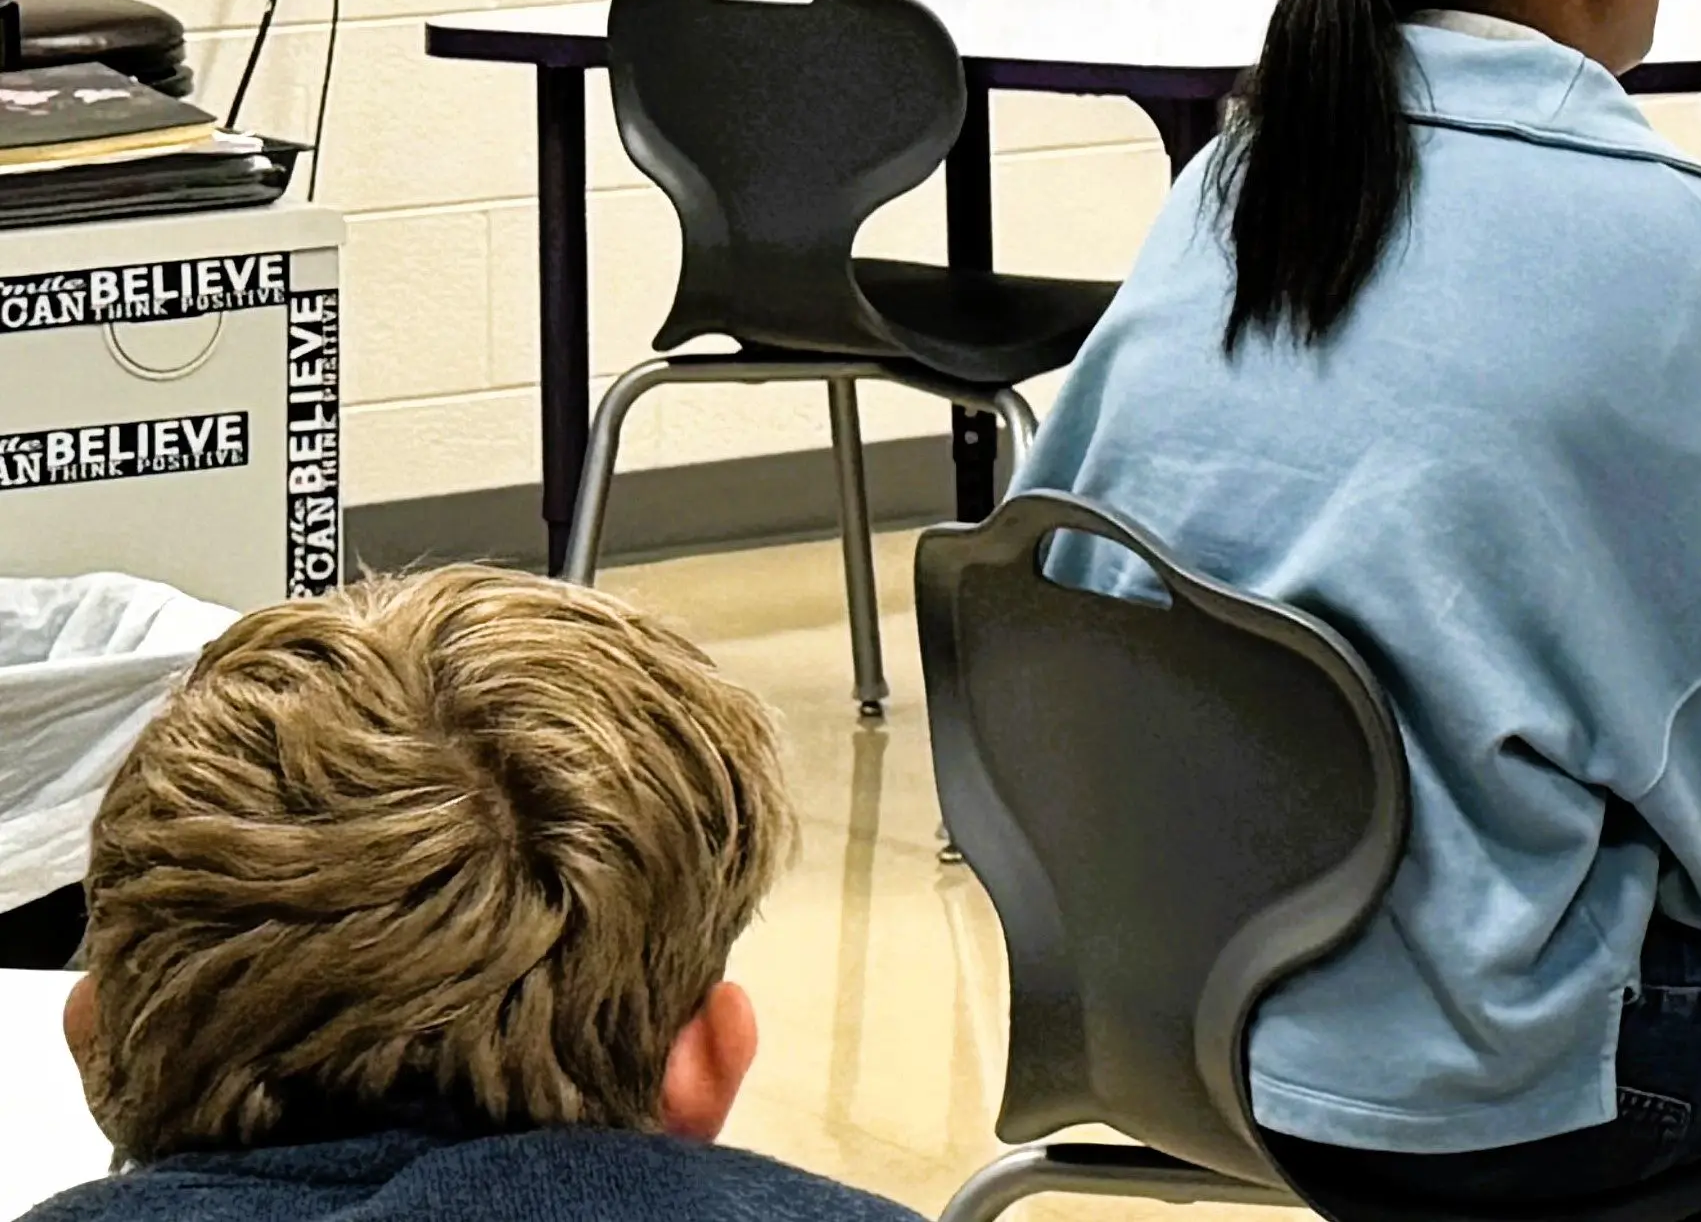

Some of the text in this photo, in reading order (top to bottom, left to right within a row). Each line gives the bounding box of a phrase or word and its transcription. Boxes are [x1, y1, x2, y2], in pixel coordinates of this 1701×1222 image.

[0, 275, 87, 297] mile
[2, 291, 87, 329] CAN
[90, 254, 285, 310] BELIEVE
[91, 286, 286, 322] THINK POSITIVE
[289, 294, 325, 495] BELIEVE
[321, 293, 338, 489] THINK POSITIVE
[47, 415, 243, 472] BELIEVE
[48, 447, 243, 483] THINK POSITIVE
[306, 496, 336, 581] CAN
